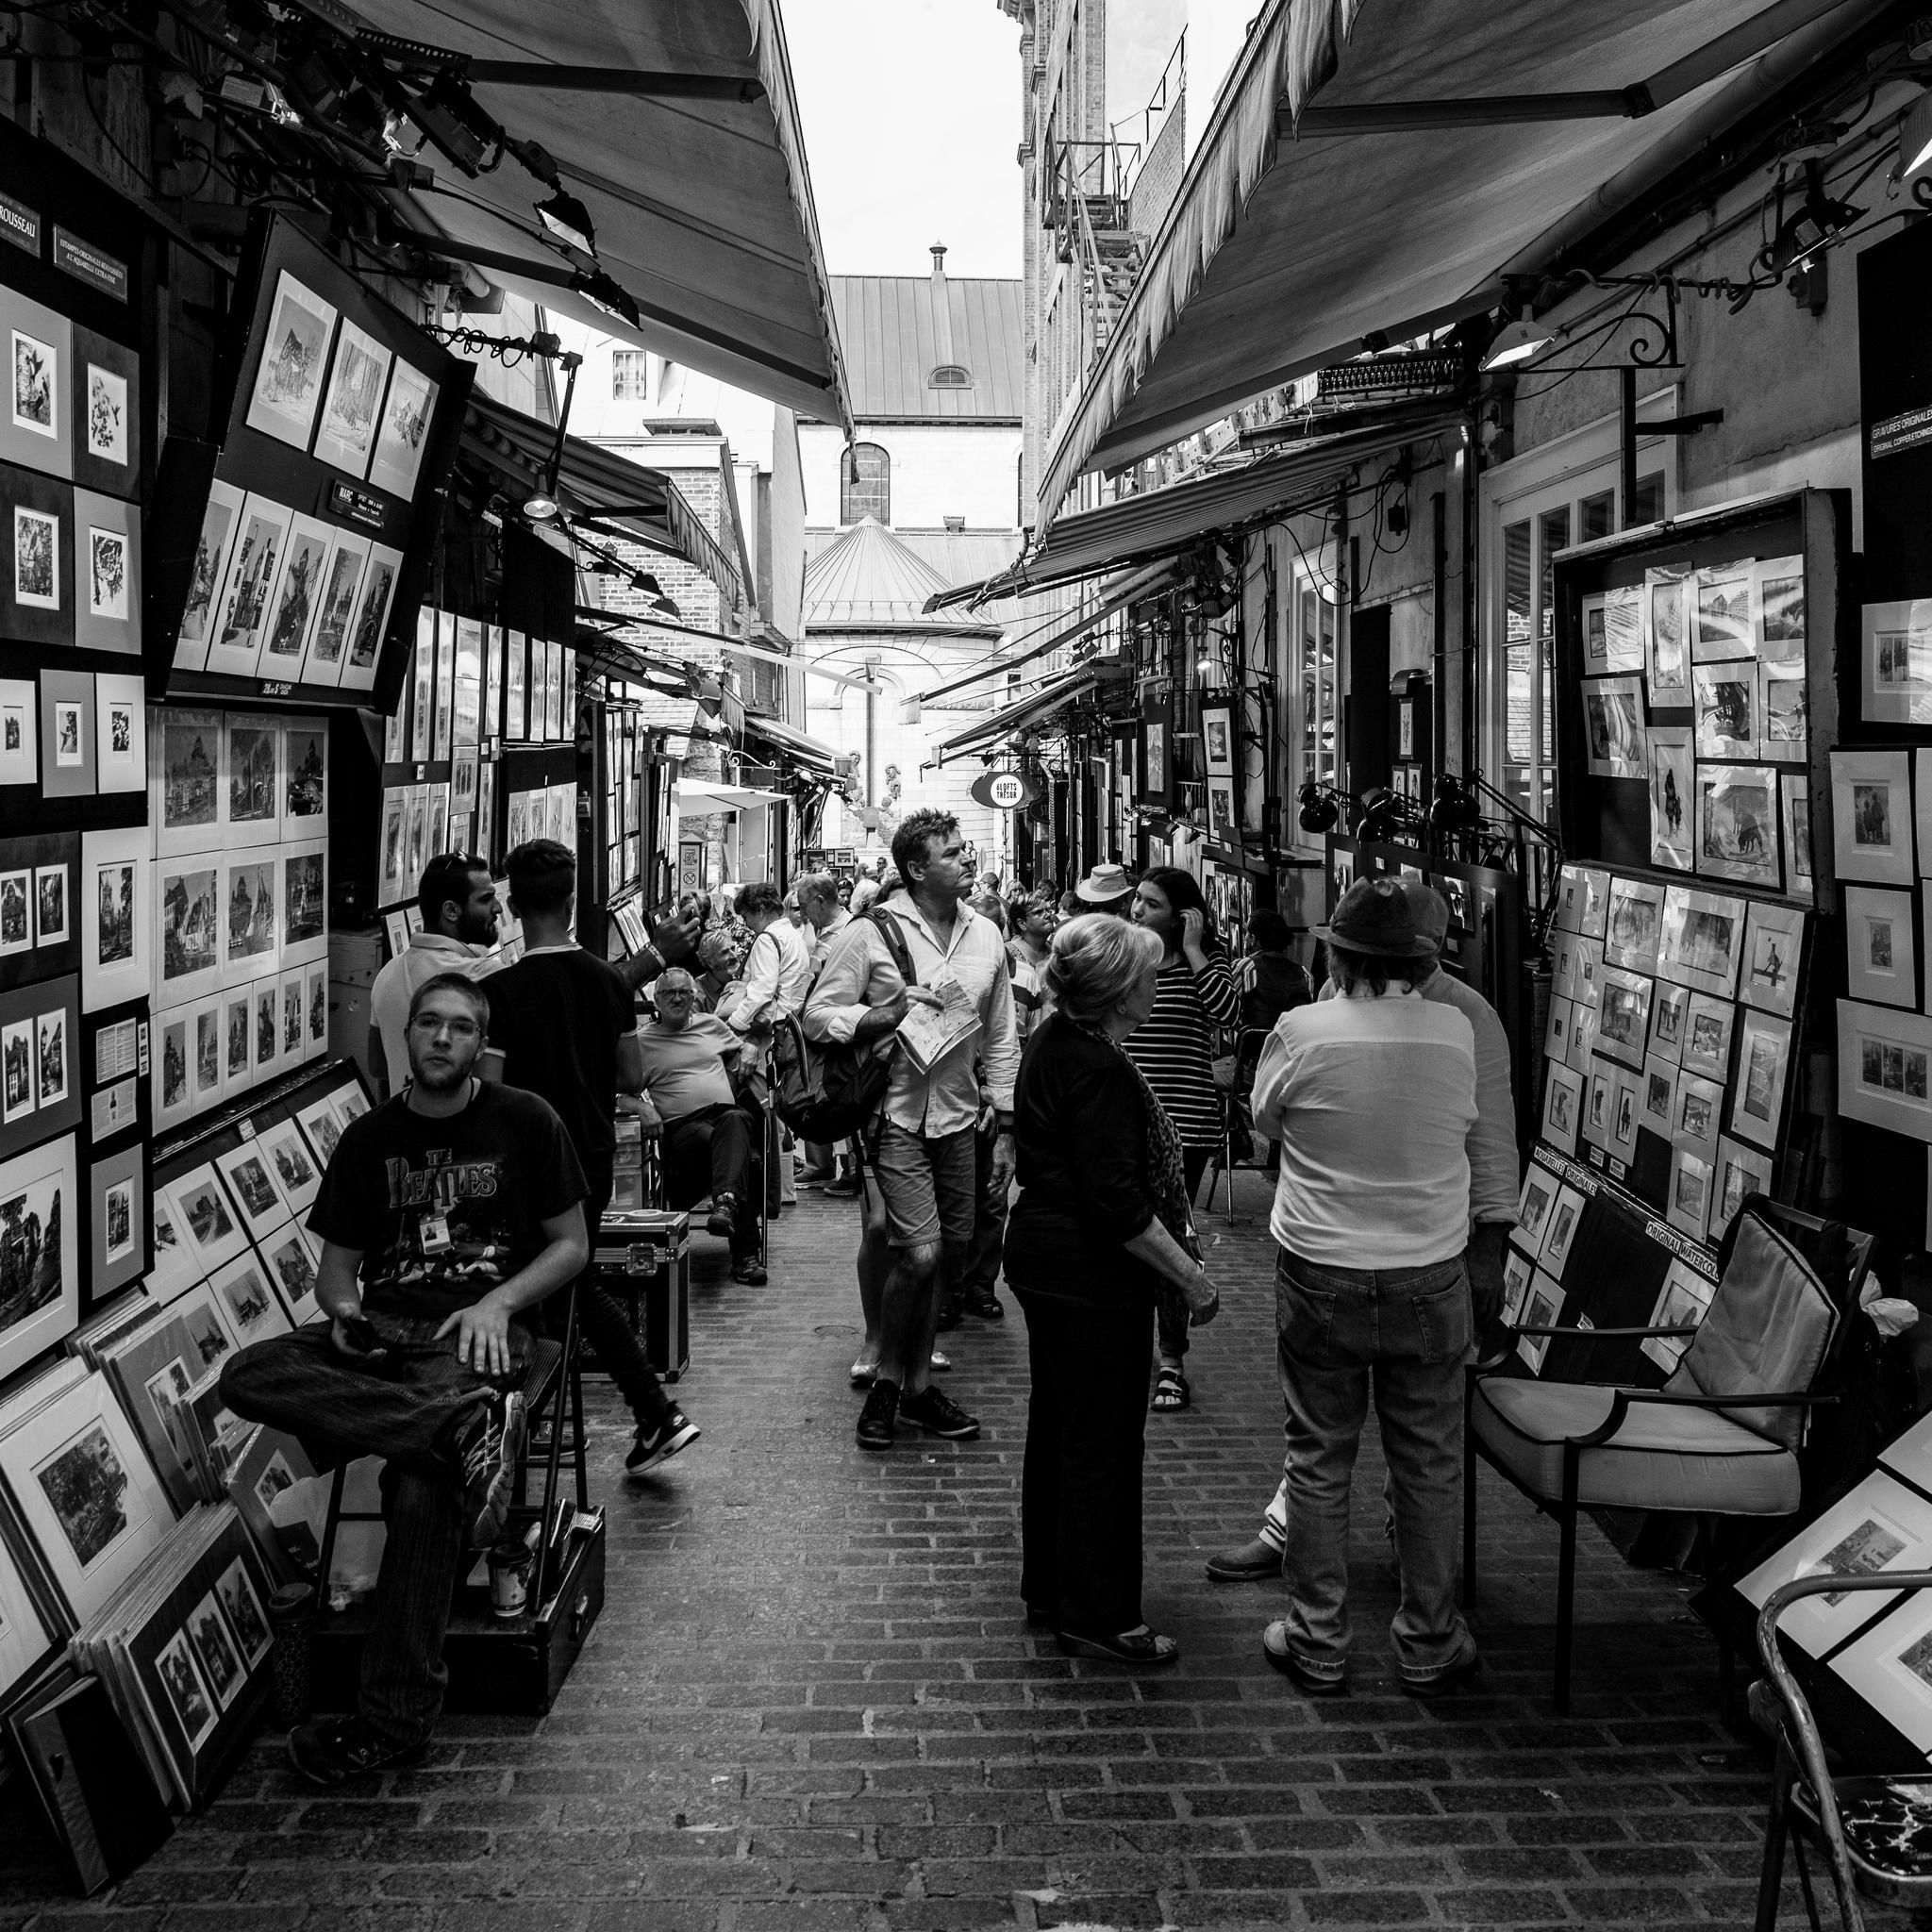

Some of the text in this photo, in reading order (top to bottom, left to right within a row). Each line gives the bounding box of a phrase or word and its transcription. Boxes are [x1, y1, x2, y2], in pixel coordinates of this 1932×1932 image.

[1873, 408, 1932, 438] GRAVURES ORIGINALE
[1873, 440, 1893, 453] ORIGINAL
[1893, 434, 1911, 446] COPPER
[425, 1147, 453, 1166] THE
[1534, 1148, 1565, 1174] AQUARELLES
[385, 1157, 497, 1208] BEATLES
[1647, 1224, 1679, 1252] ORIGINAL
